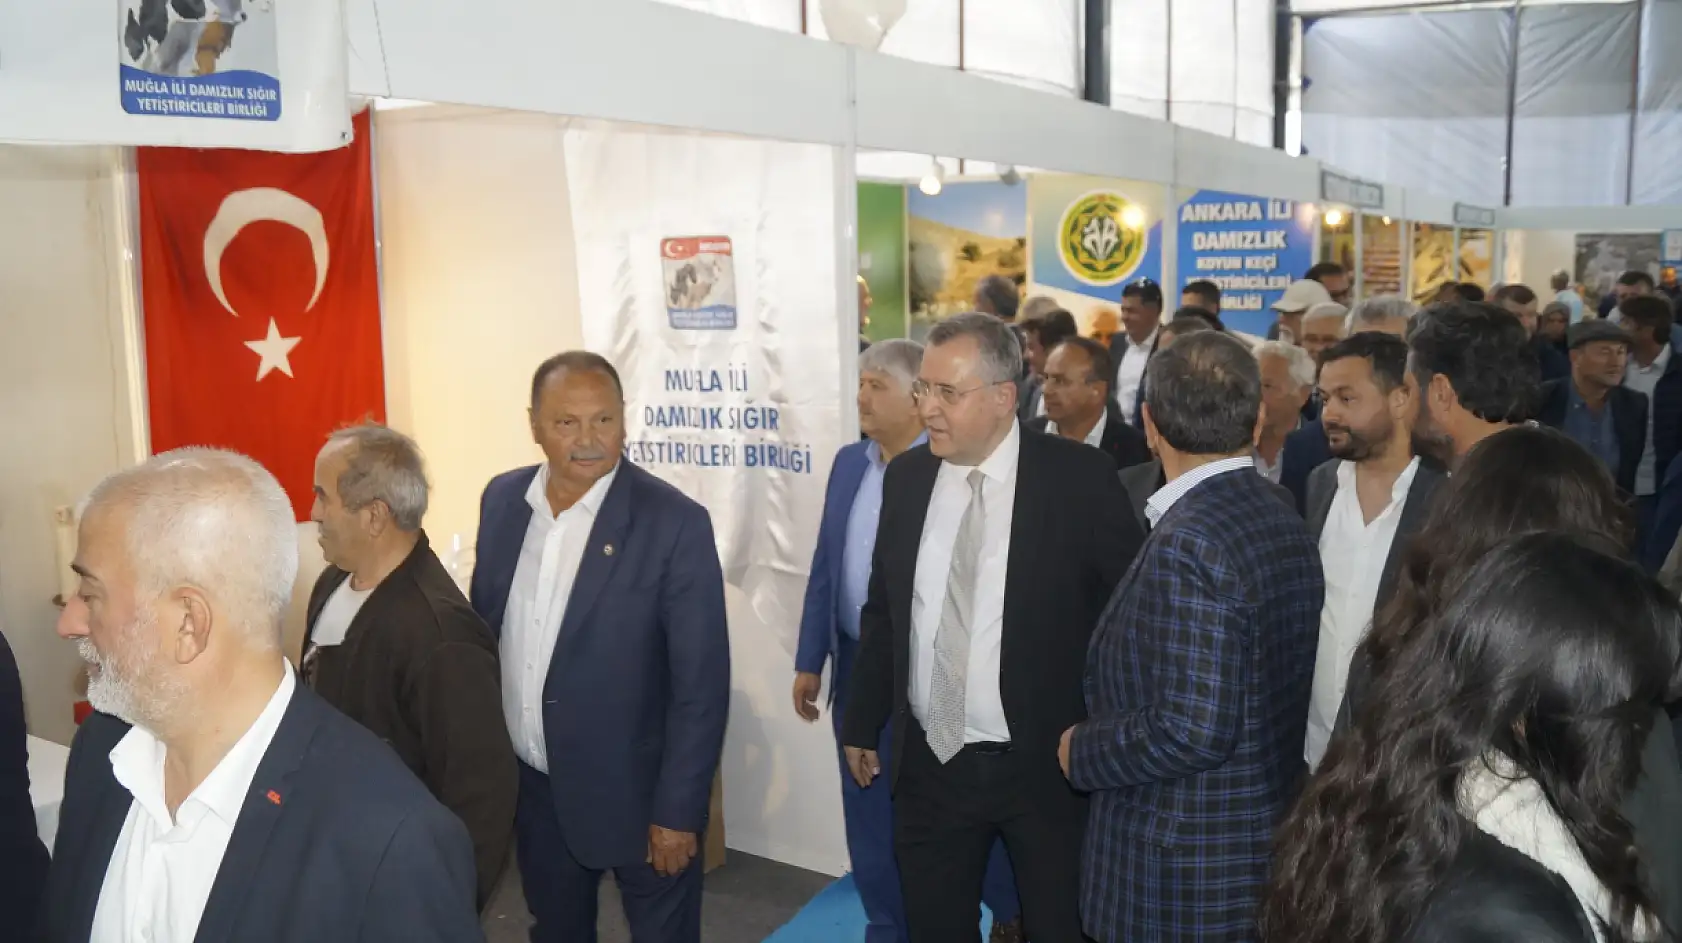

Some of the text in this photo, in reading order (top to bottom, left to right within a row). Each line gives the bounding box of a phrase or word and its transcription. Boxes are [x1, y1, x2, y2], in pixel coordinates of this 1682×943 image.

[125, 77, 277, 100] MUĞLA İLİ DAMIZLIK SIĞIR
[136, 96, 267, 117] YETİŞTİRİCİLERİ BİRLİĞİ
[1182, 202, 1262, 222] ANKARA
[1193, 230, 1287, 250] DAMIZLIK
[728, 362, 748, 392] İLİ
[728, 399, 779, 430] SIĞIR
